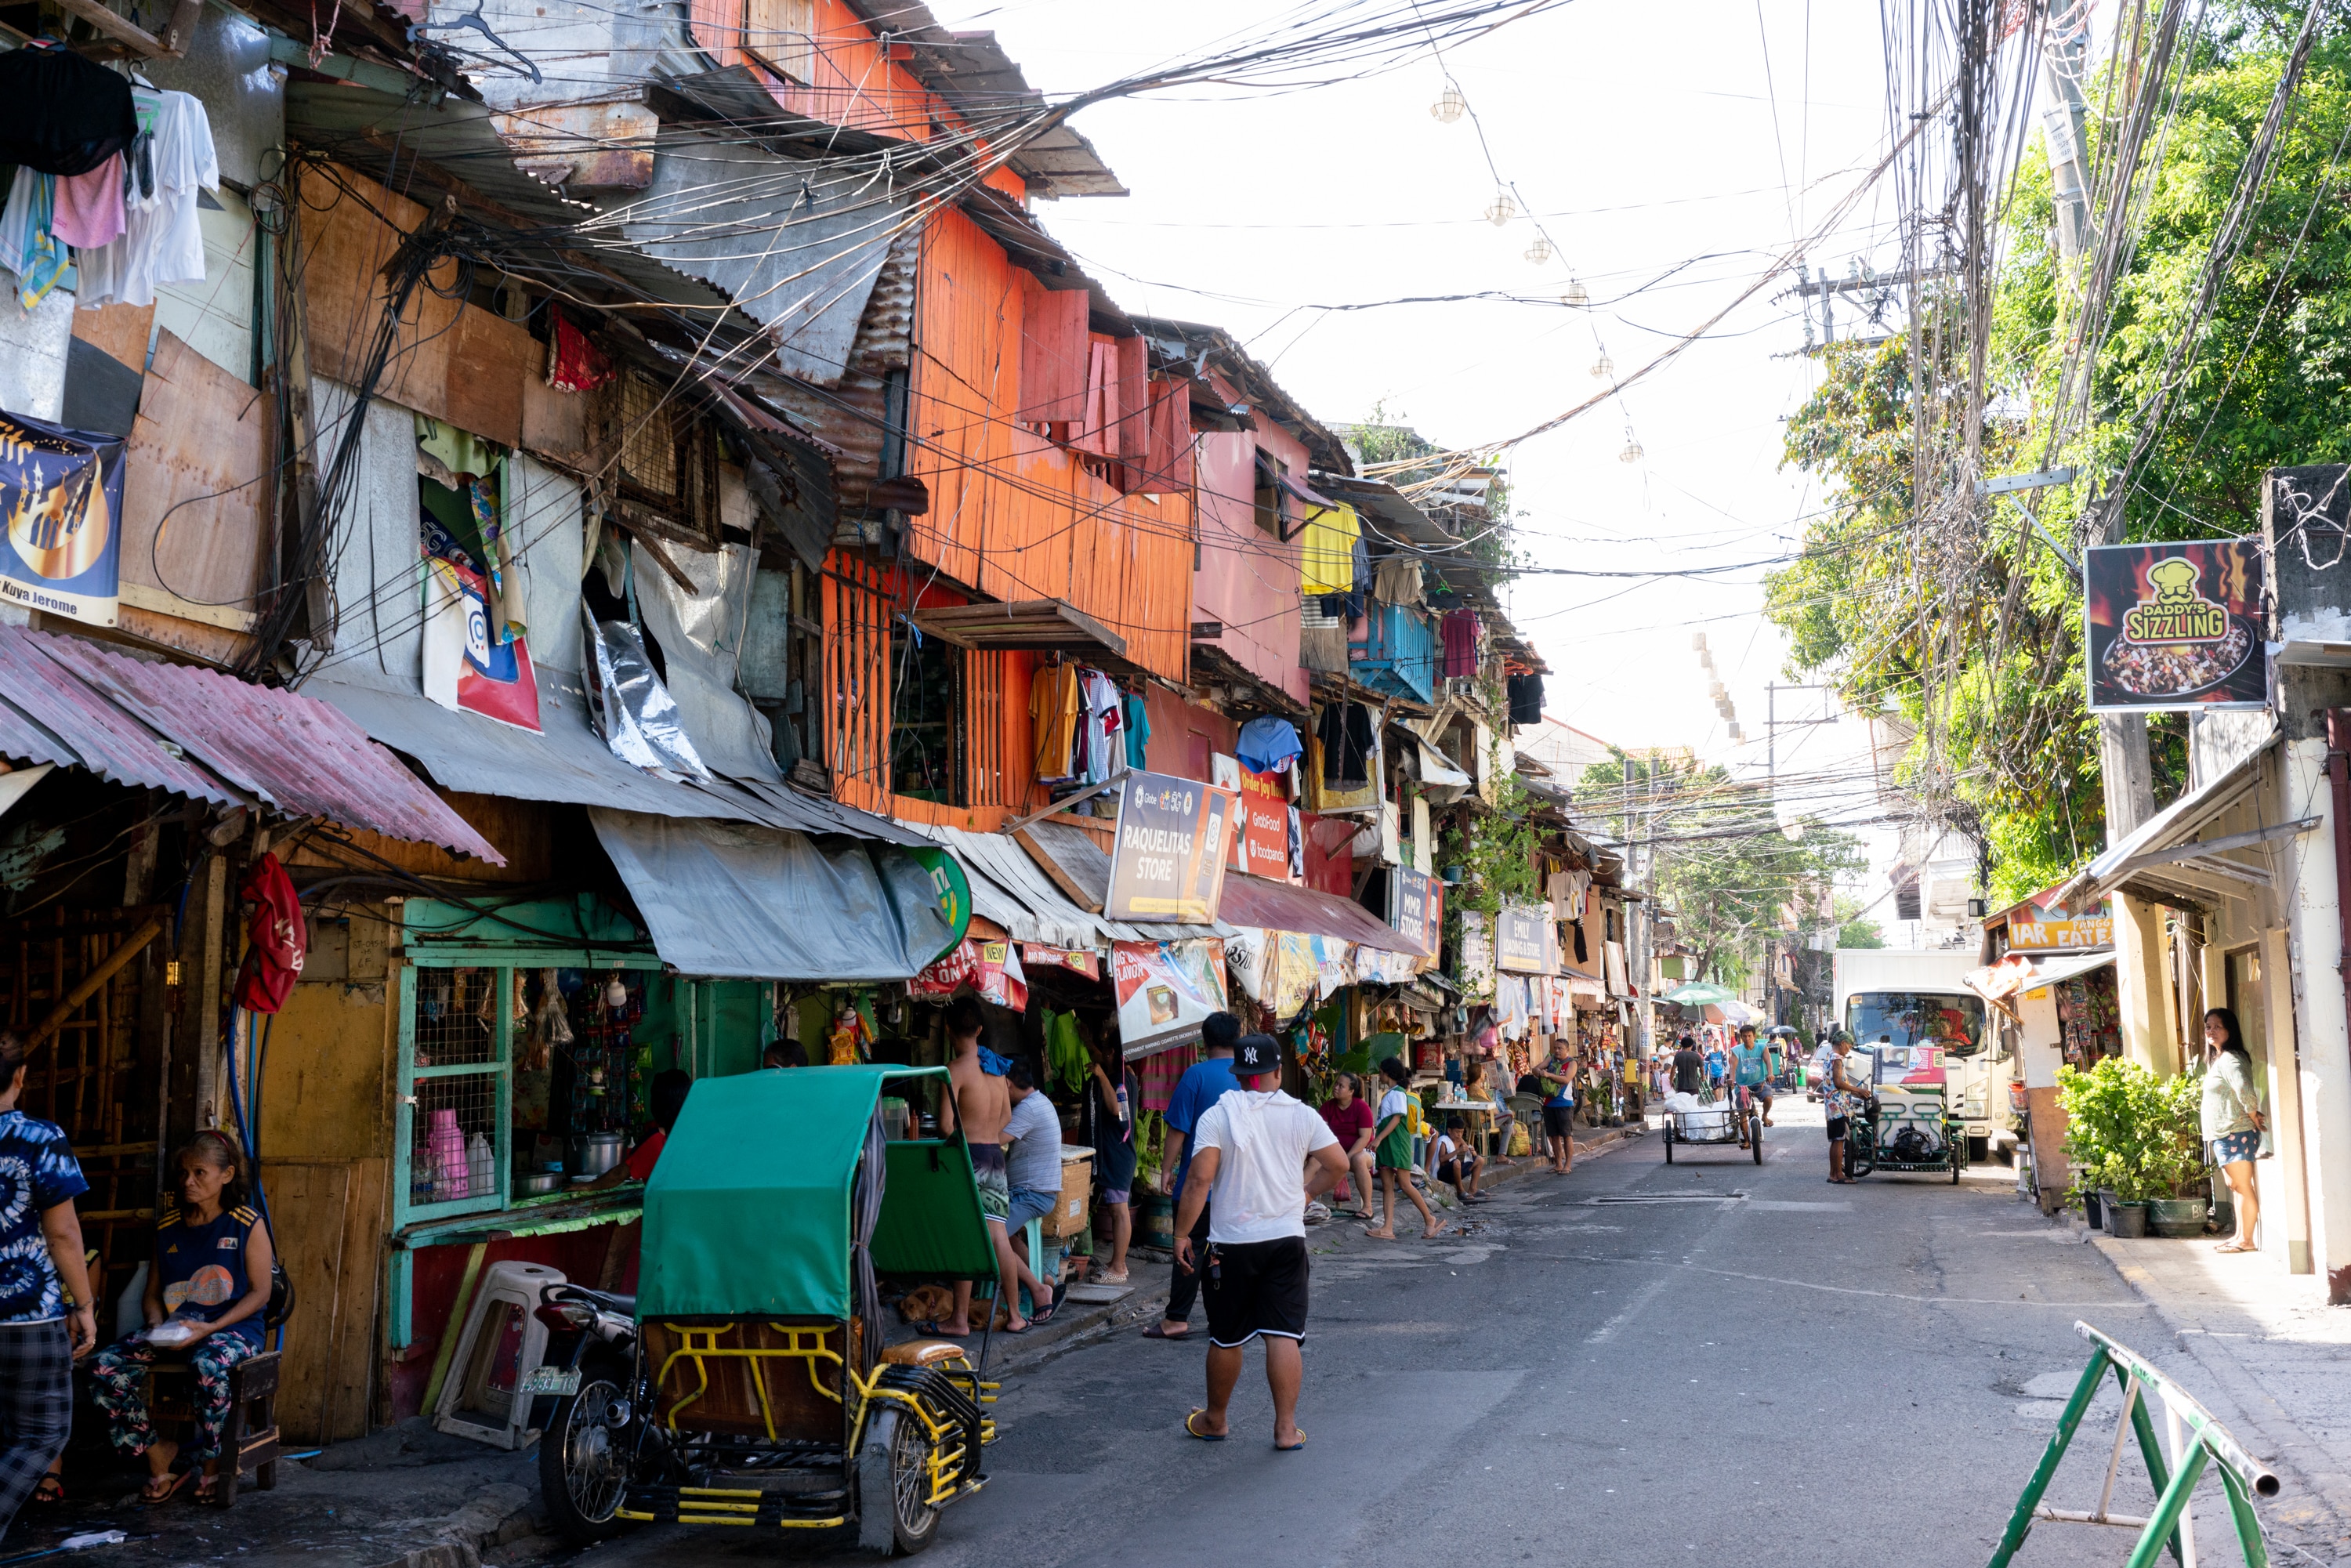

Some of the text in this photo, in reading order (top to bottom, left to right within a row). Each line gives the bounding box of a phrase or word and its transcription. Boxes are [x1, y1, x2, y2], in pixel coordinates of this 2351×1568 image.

[0, 420, 34, 465] itr
[2, 581, 77, 614] Kuya Jerome
[2143, 603, 2207, 616] DADDY'S
[2128, 609, 2223, 639] SIZZLING
[1241, 772, 1260, 792] Order
[1260, 777, 1270, 800] Joy
[1144, 792, 1157, 805] Globe
[1252, 811, 1281, 832] GrabFood
[1123, 825, 1191, 855] RAQUELITAS
[1257, 842, 1284, 864] foodpanda
[1136, 856, 1172, 882] STORE
[1404, 893, 1421, 918] MMR
[1400, 914, 1422, 940] STORE
[1514, 920, 1530, 940] EMILY
[986, 947, 1004, 960] NEW
[1503, 938, 1541, 958] LOADING & STORE
[939, 966, 962, 983] ON
[1934, 1052, 1943, 1066] NEW
